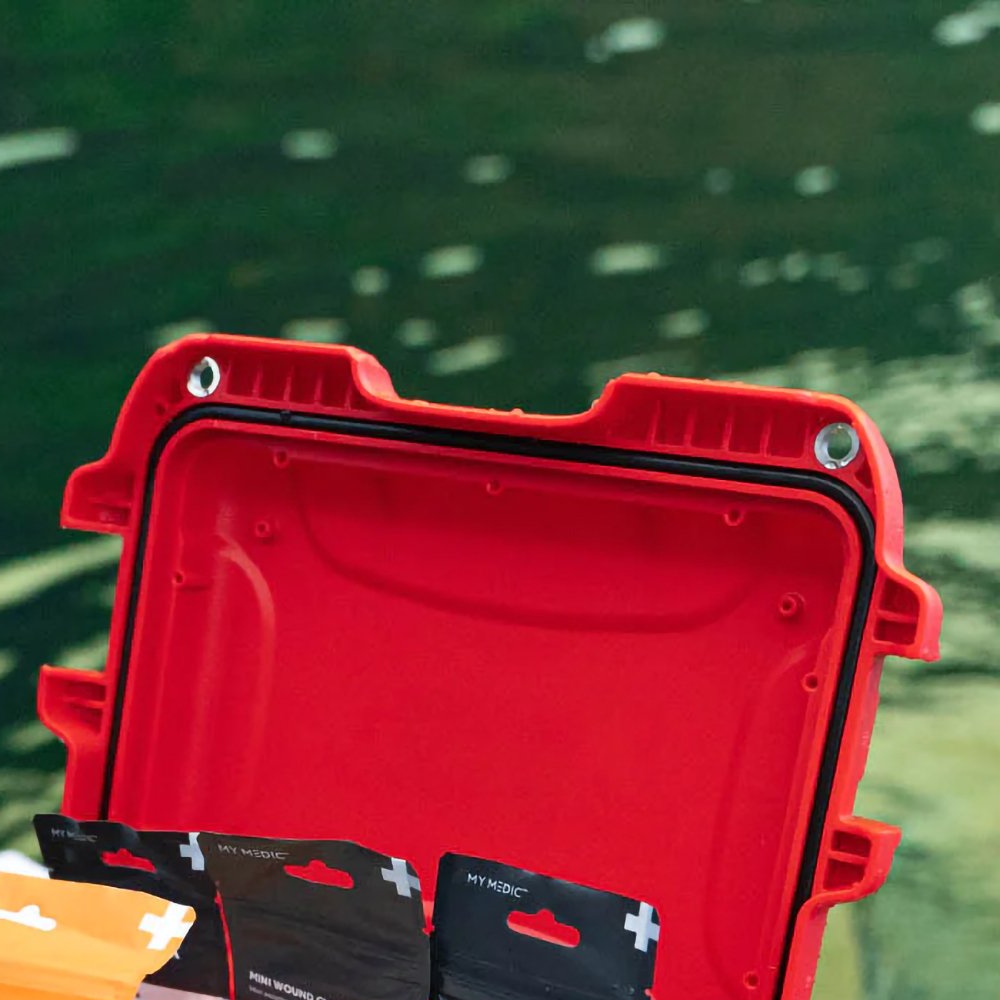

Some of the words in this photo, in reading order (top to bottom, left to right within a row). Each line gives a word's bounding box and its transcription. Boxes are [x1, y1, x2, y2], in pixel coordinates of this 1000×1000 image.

[218, 844, 237, 856] MY
[241, 848, 289, 860] MEDIC
[467, 873, 486, 887] MY
[487, 879, 528, 898] MEDIC
[249, 971, 272, 986] MINI
